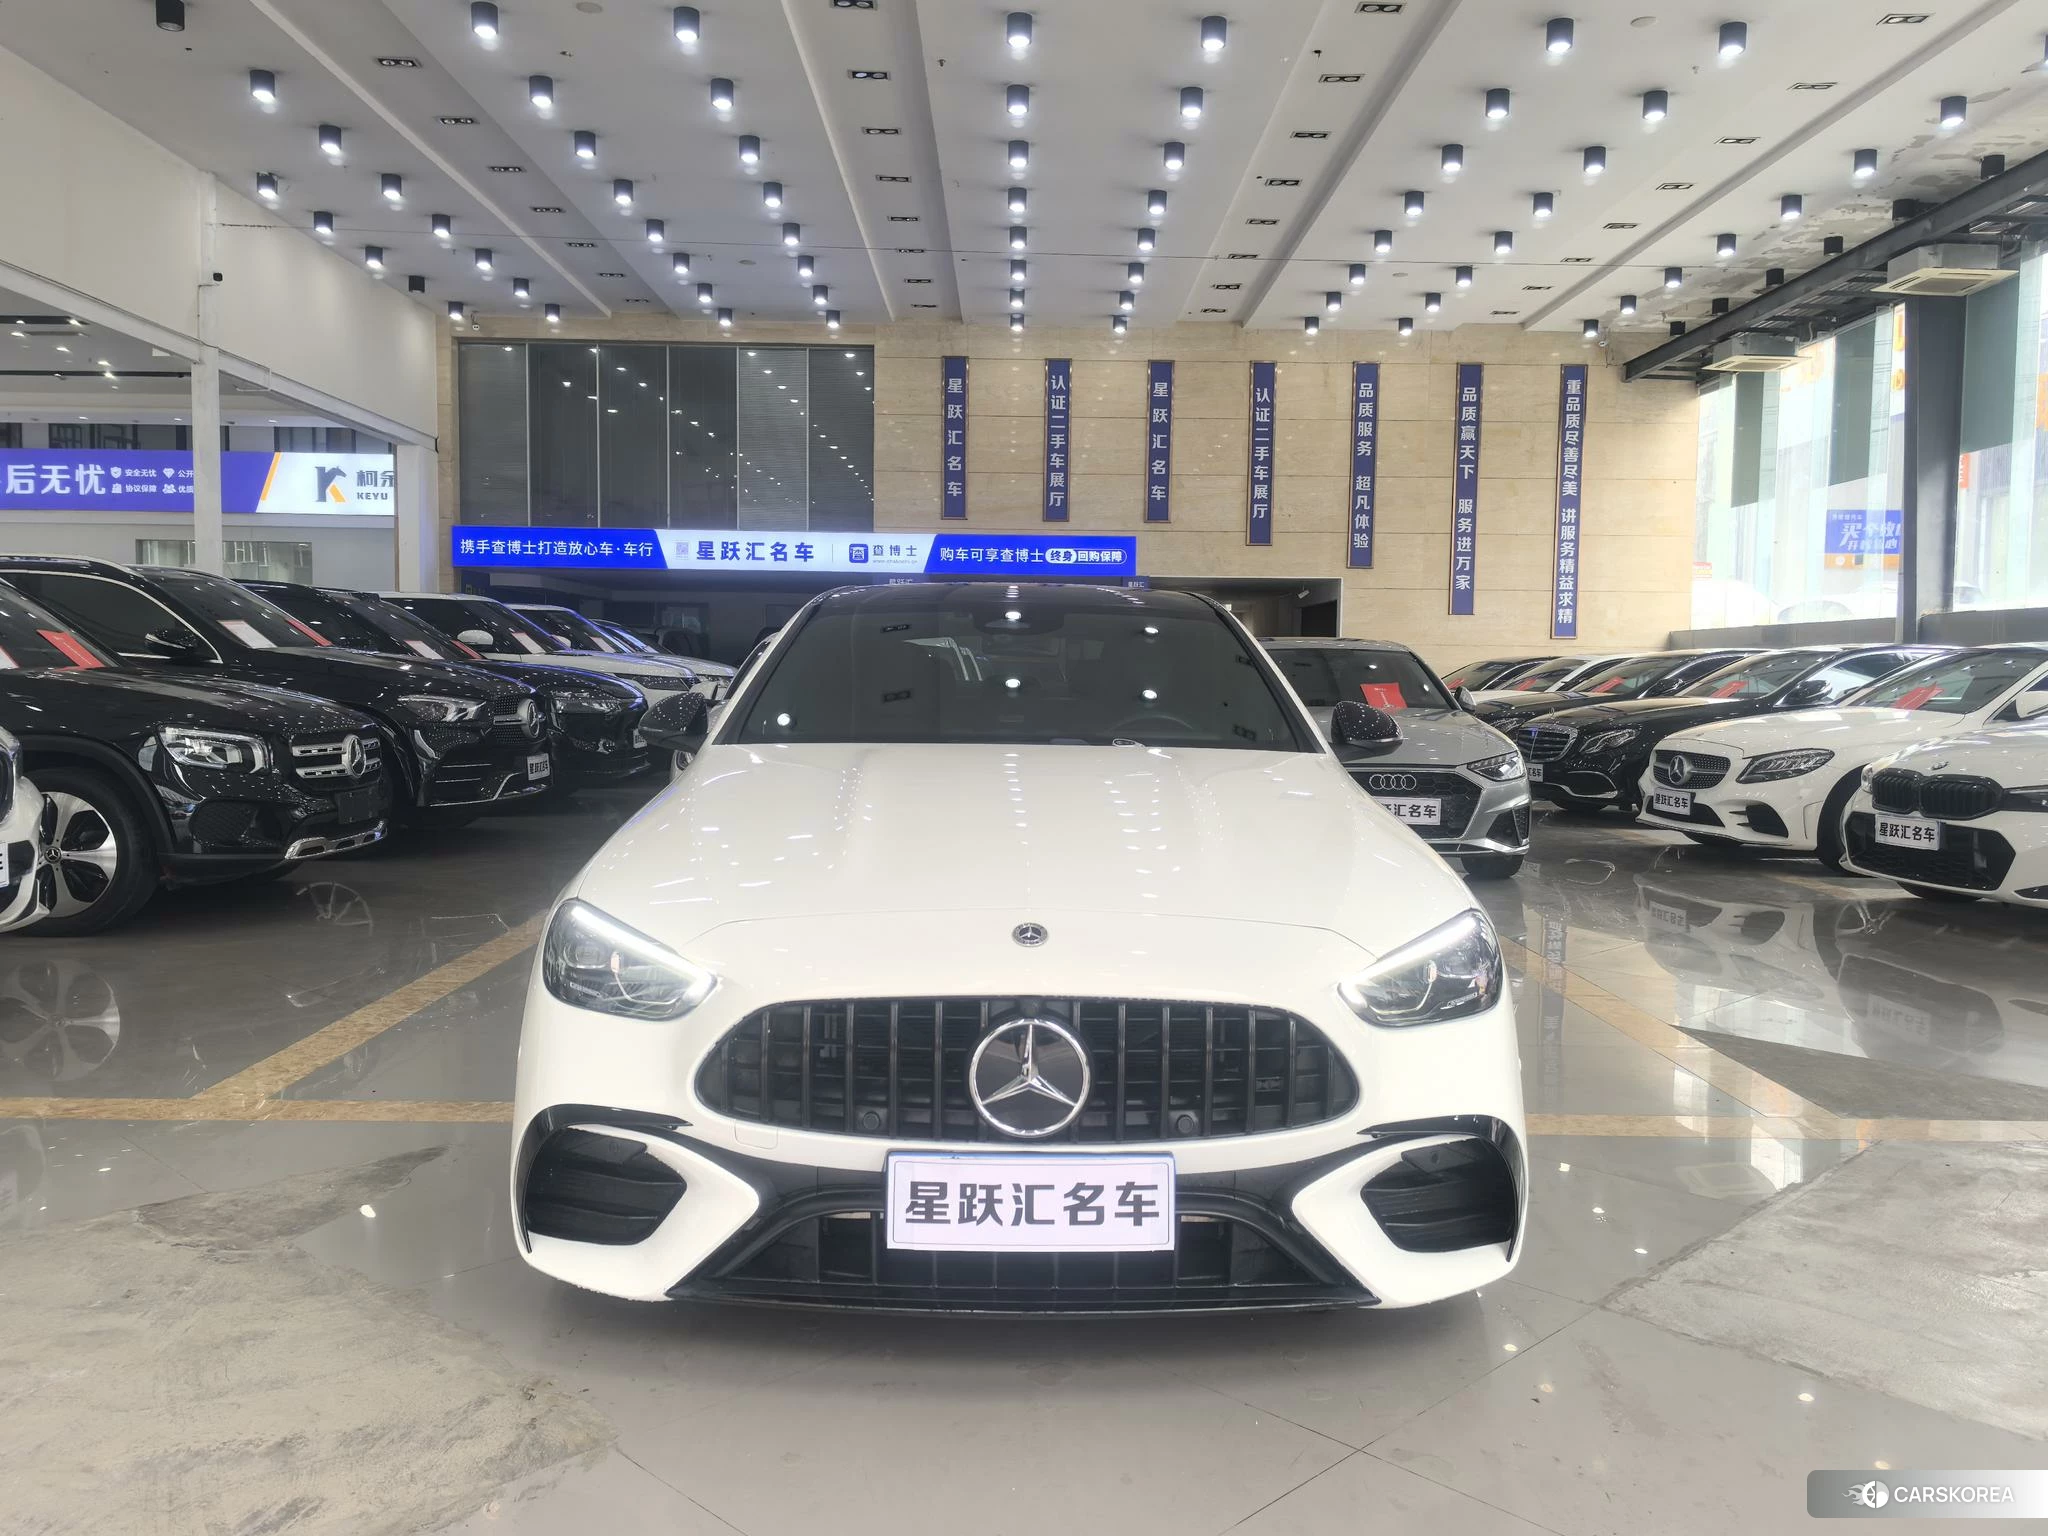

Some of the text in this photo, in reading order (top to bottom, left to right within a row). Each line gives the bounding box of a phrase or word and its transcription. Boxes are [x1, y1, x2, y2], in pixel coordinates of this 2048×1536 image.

[125, 469, 157, 477] 安全无忧
[947, 378, 963, 497] 星跃汇名车
[1048, 374, 1067, 508] 认证二手车展厅
[1151, 382, 1169, 501] 星跃汇名车
[1252, 387, 1271, 520] 认证二手车展厅
[1353, 383, 1374, 549] 品质服务 超凡体验
[357, 492, 388, 500] KEYU
[1455, 386, 1478, 590] 品质赢天下 服务进万家
[1557, 379, 1582, 624] 重品质尽善尽美 讲服务精益求精
[460, 539, 653, 557] 携手查博士打造放心车·车行
[696, 540, 814, 563] 星跃汇名车
[1382, 804, 1437, 818] 汇名车
[1879, 822, 1936, 843] 星跃汇名车
[905, 1181, 1160, 1227] 星跃汇名车
